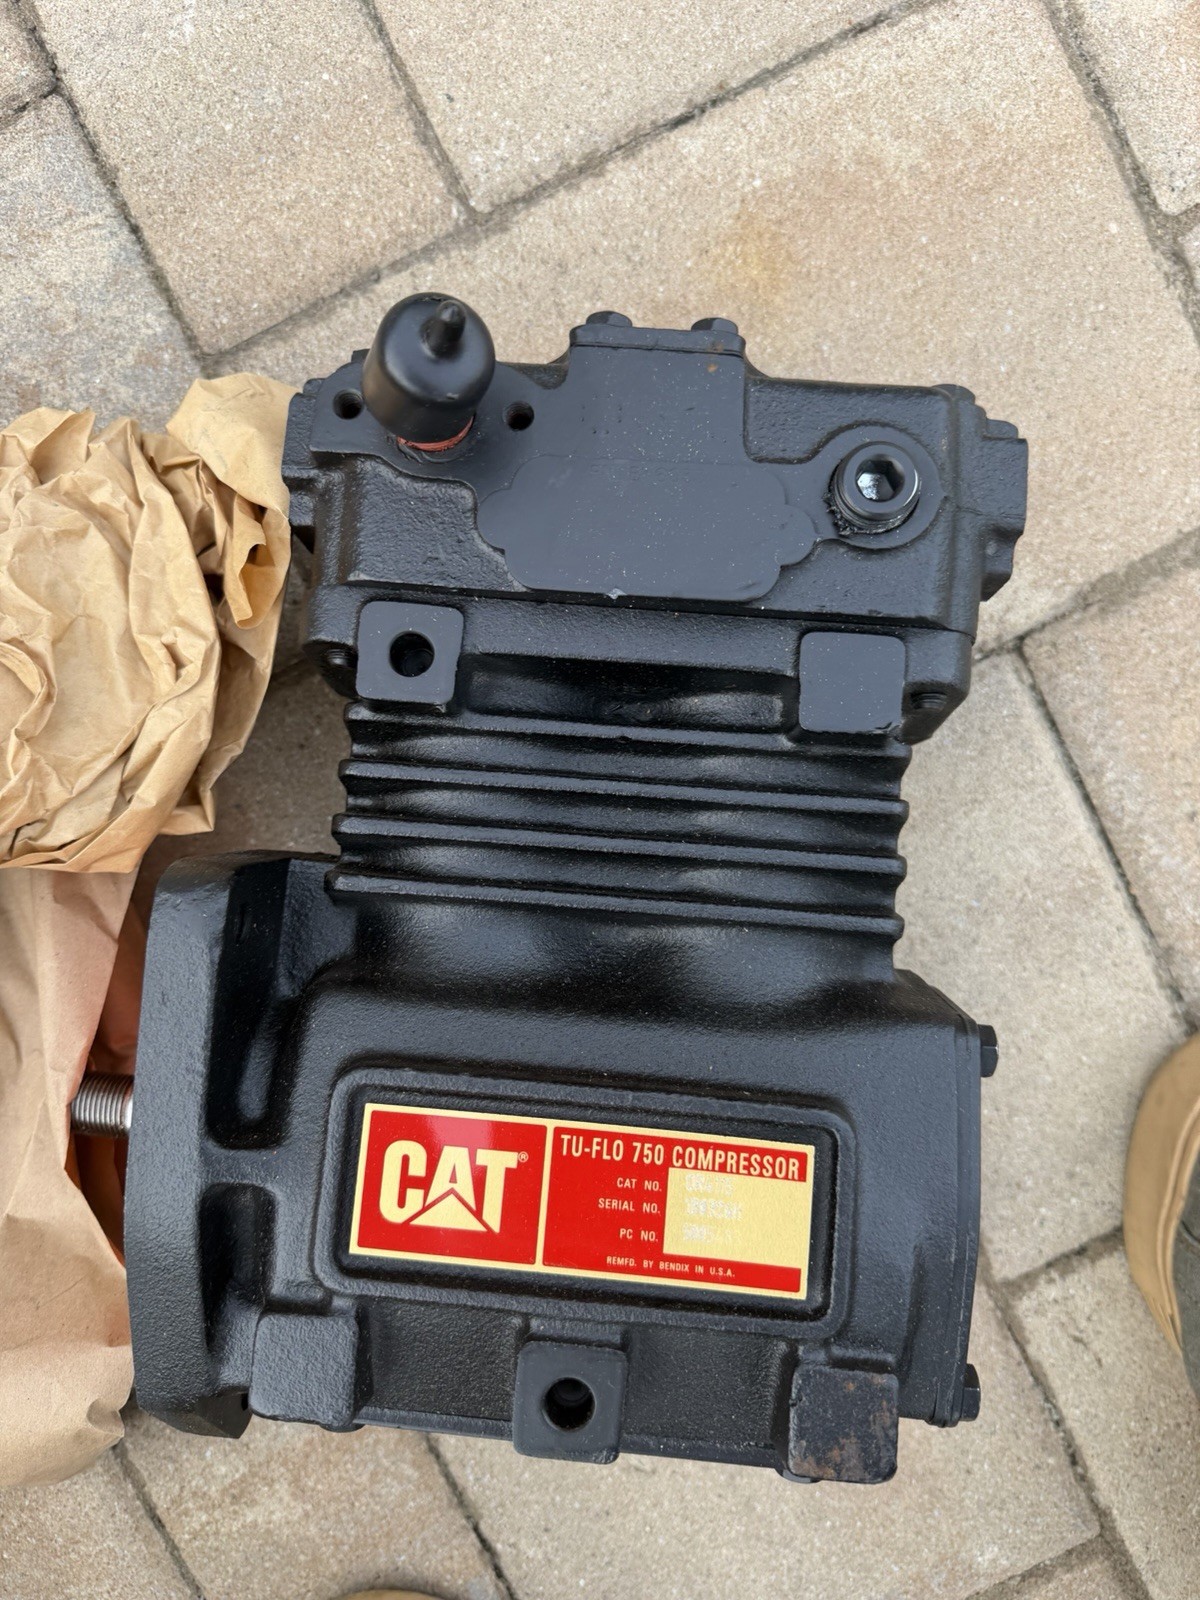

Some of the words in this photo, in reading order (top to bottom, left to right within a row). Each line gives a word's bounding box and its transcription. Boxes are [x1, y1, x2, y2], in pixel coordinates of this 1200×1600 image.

[560, 1133, 625, 1162] TU-FLO
[632, 1141, 665, 1166] 750
[671, 1145, 801, 1181] COMPRESSOR
[379, 1139, 519, 1234] CAT
[616, 1177, 637, 1189] CAT
[644, 1179, 663, 1192] NO.
[598, 1197, 635, 1212] SERIAL
[642, 1202, 661, 1214] NO.
[619, 1228, 634, 1240] PC
[640, 1229, 659, 1242] NO.
[606, 1255, 638, 1267] REMFD.
[642, 1259, 654, 1269] BY
[658, 1260, 690, 1273] BENDIX
[694, 1264, 704, 1274] IN
[708, 1266, 736, 1278] U.S.A.
